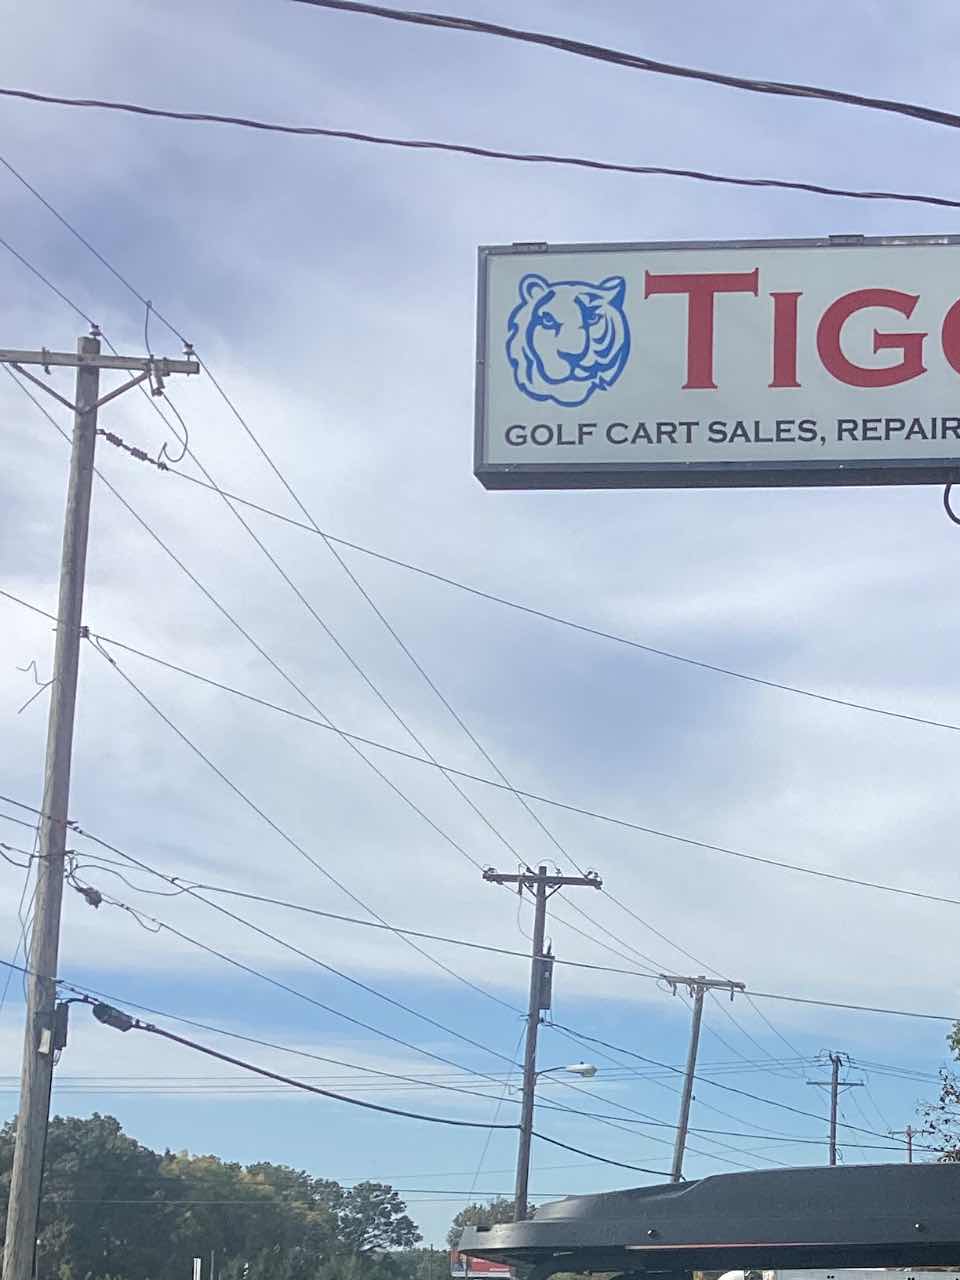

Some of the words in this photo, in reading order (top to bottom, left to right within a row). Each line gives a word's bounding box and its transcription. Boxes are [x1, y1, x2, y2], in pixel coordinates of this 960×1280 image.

[505, 421, 597, 446] GOLF
[606, 421, 699, 445] CART
[707, 418, 826, 447] SALES,
